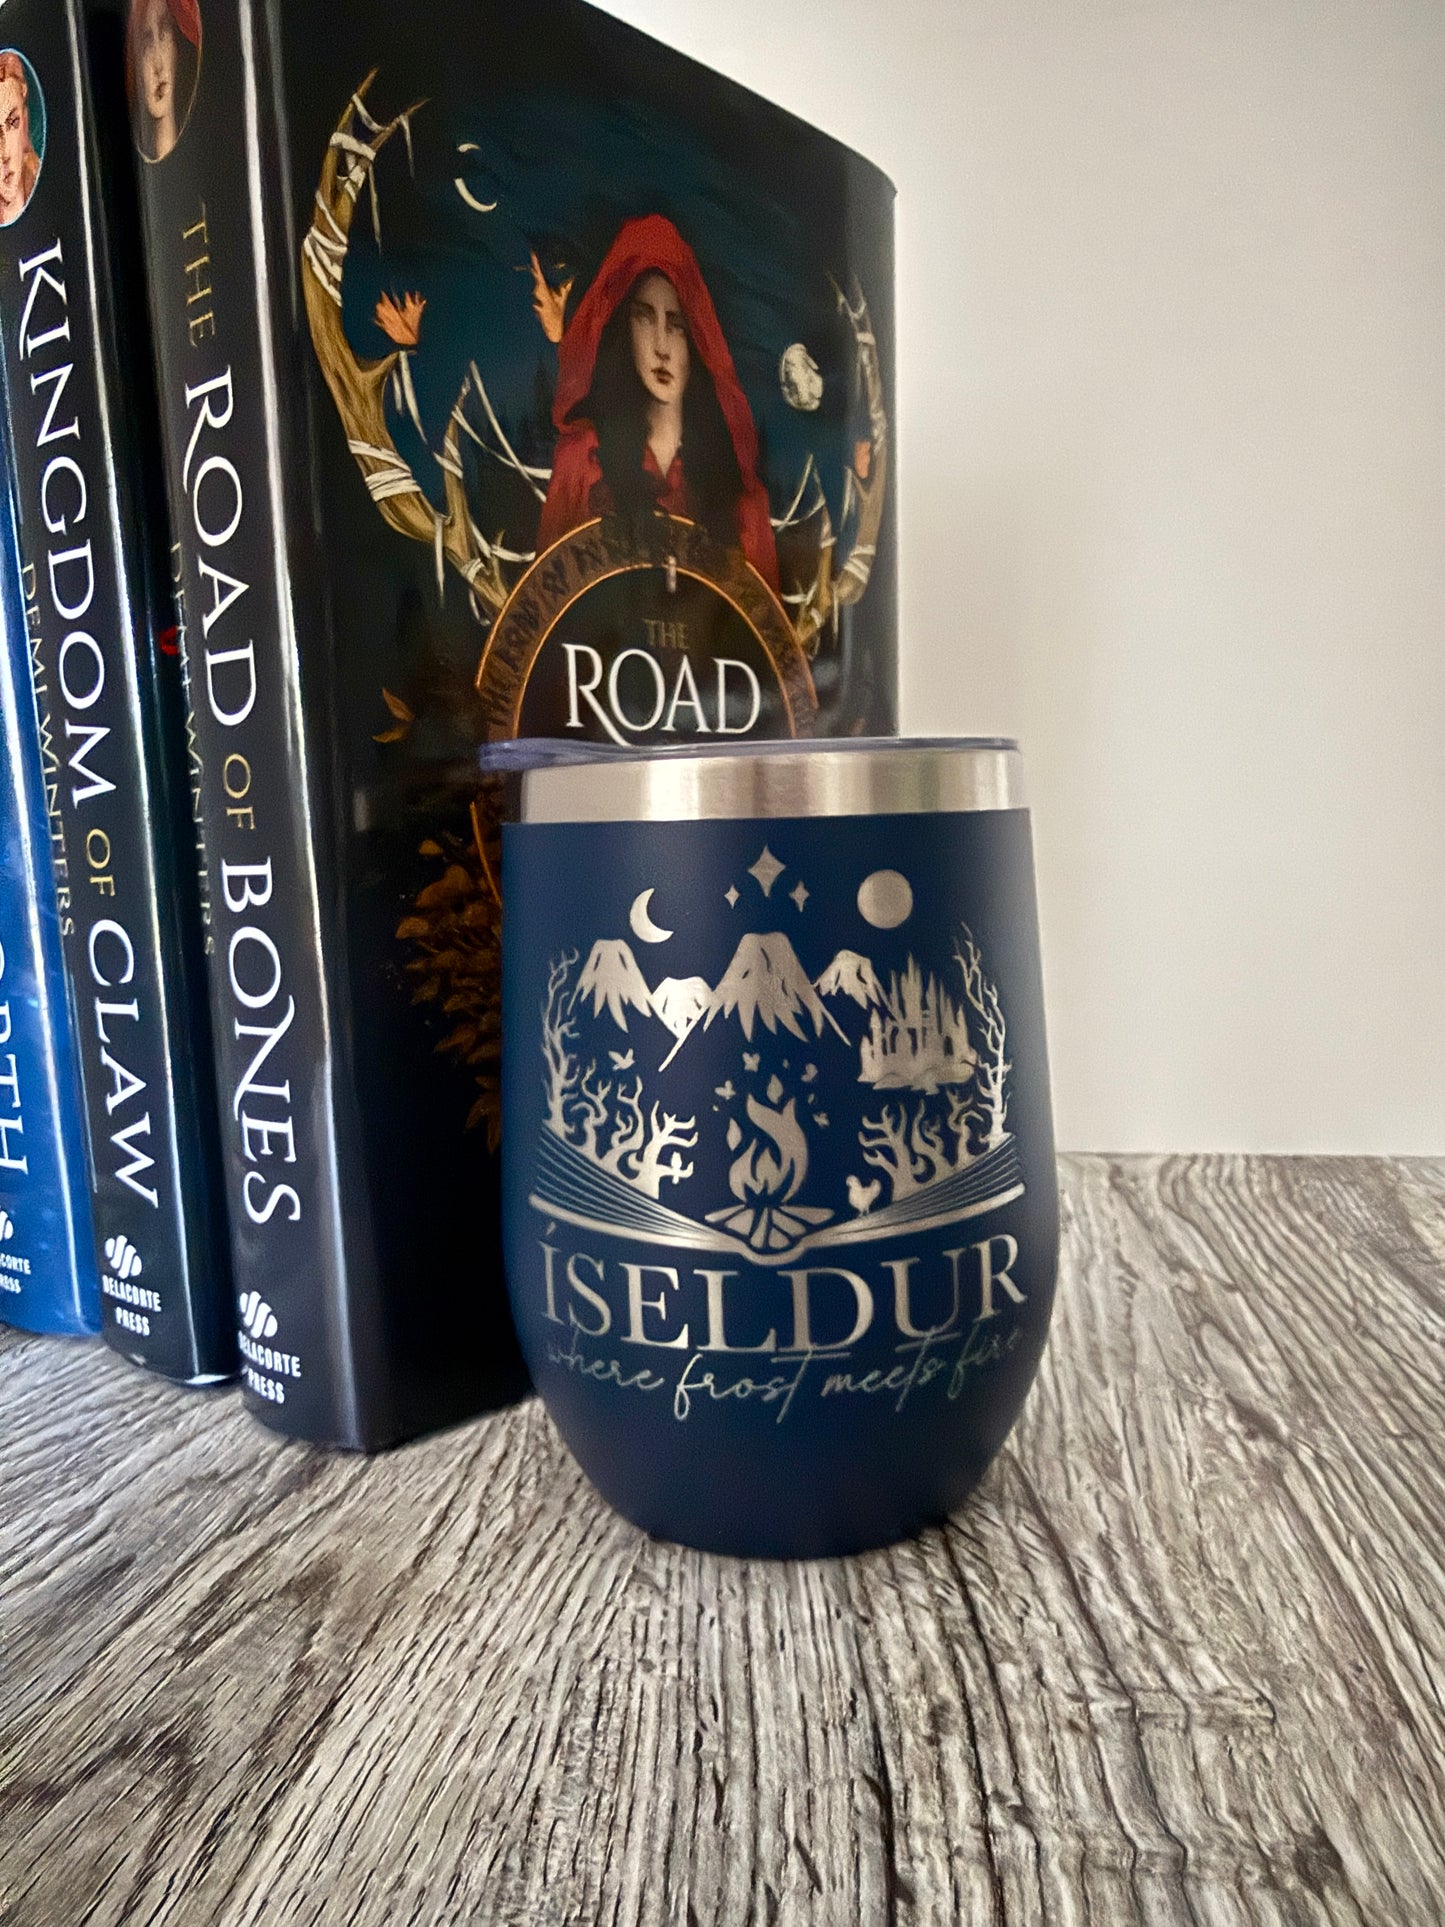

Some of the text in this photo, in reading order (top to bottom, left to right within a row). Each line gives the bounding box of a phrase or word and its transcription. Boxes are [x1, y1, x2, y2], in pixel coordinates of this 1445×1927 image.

[644, 618, 690, 650] THE
[18, 236, 159, 1209] KINGDOM OF CLAW
[182, 202, 302, 1225] THE ROAD OF BONES
[561, 642, 761, 746] ROAD
[22, 562, 75, 937] DEMI WINTERS
[102, 1274, 162, 1312] DELACORTE
[115, 1306, 150, 1337] PRESS
[539, 1222, 1028, 1354] ÍSELDUR
[248, 1367, 285, 1404] PRESS
[673, 1345, 849, 1424] frost
[821, 1325, 962, 1412] meets
